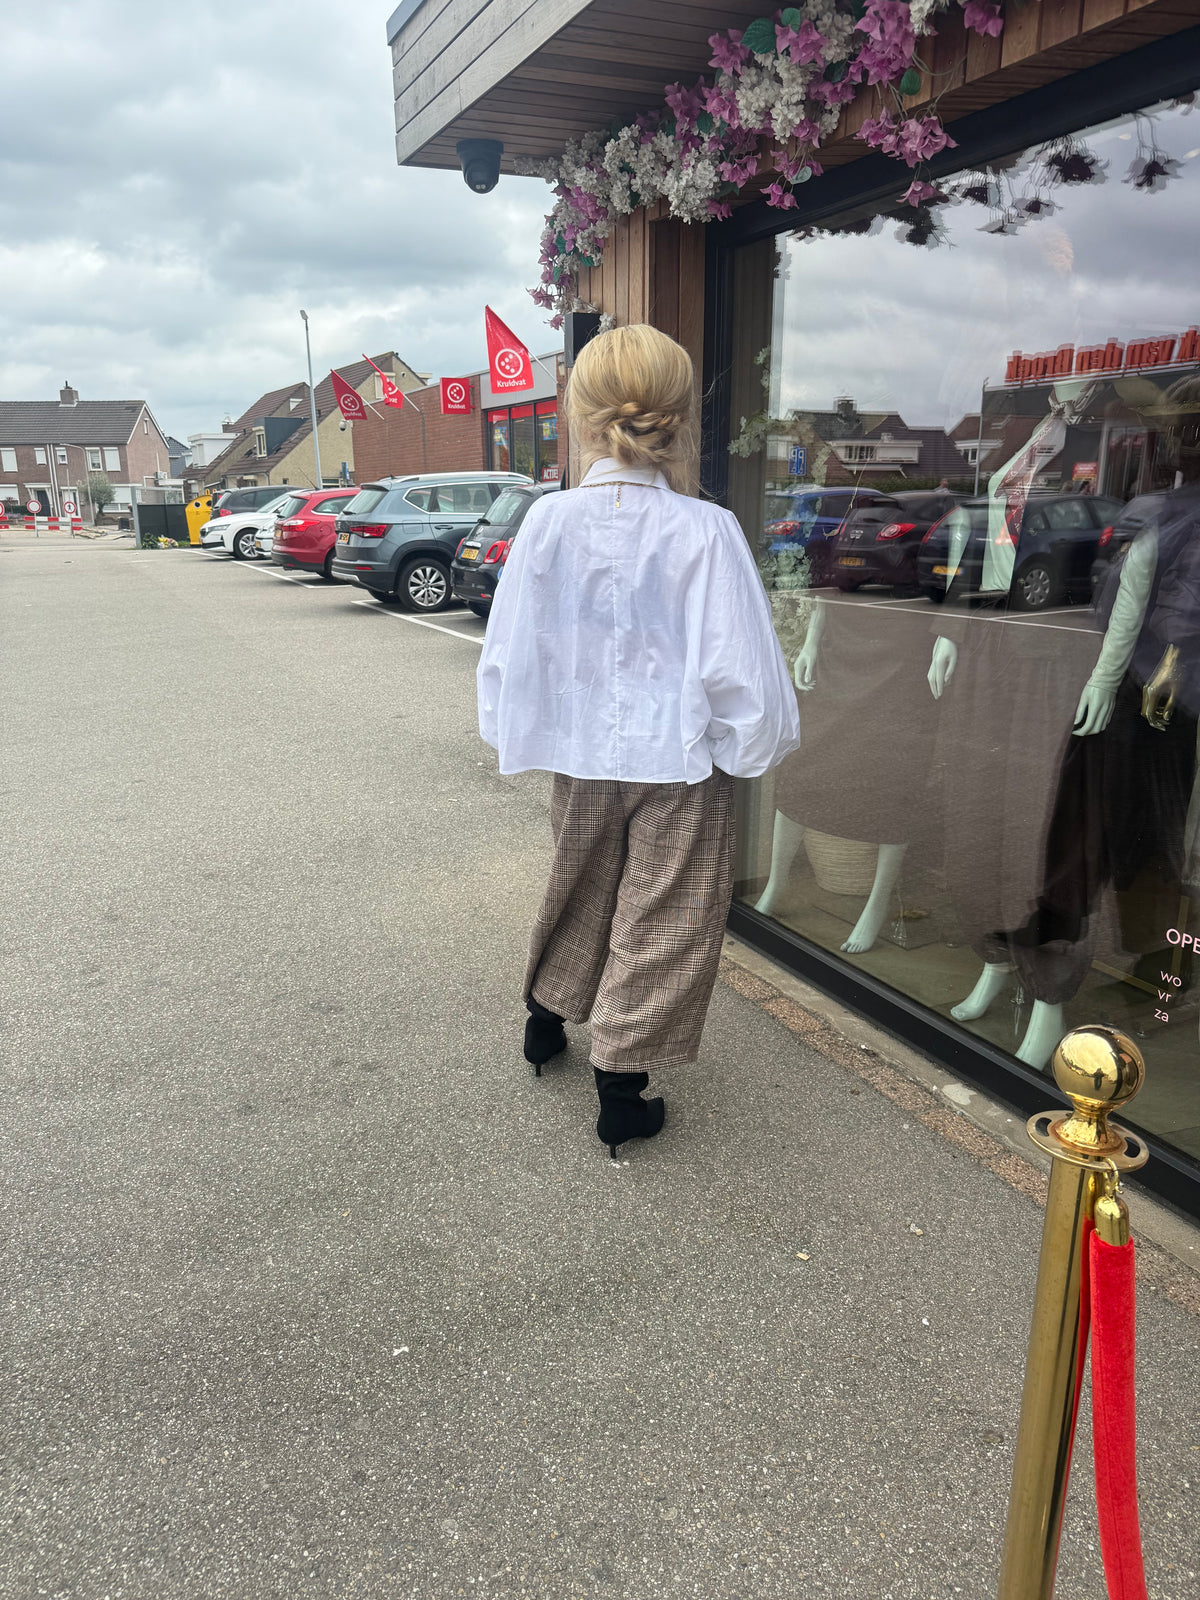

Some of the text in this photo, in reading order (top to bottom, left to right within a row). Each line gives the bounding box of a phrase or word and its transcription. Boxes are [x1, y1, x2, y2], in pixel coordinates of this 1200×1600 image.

[497, 379, 527, 388] Kruidvat
[1160, 970, 1182, 987] wo
[1157, 989, 1172, 1003] vr
[1153, 1008, 1169, 1022] za
